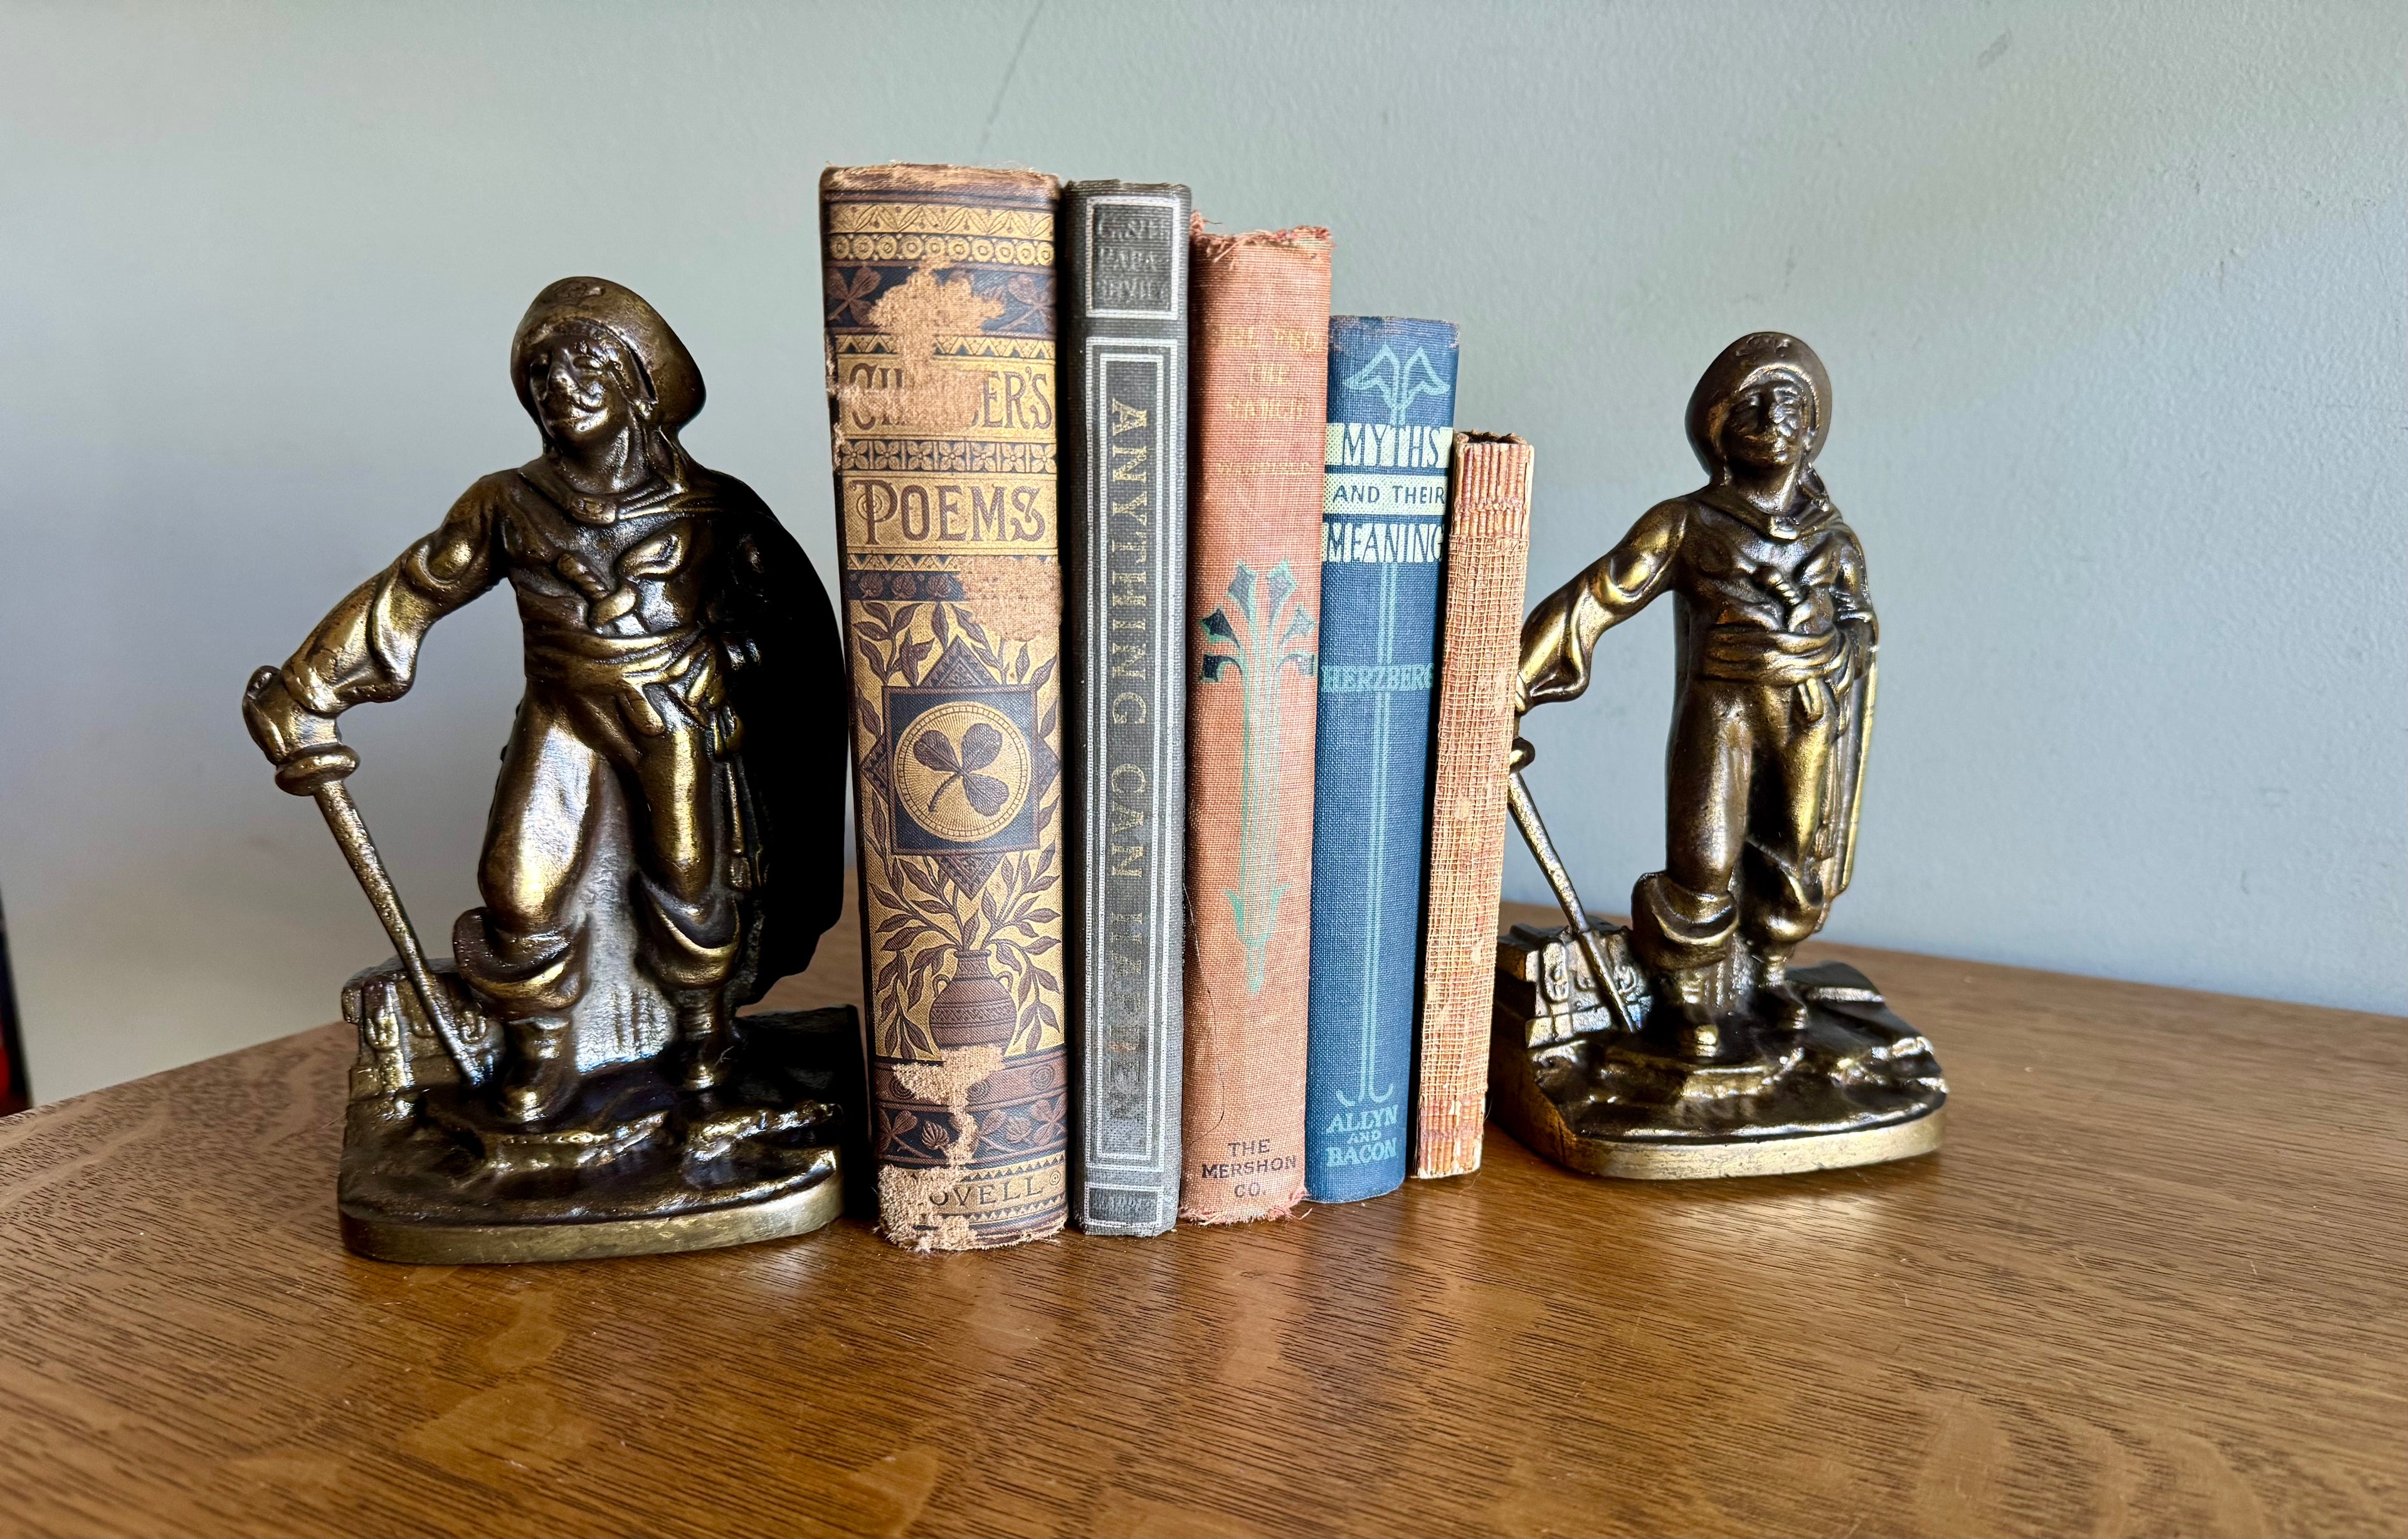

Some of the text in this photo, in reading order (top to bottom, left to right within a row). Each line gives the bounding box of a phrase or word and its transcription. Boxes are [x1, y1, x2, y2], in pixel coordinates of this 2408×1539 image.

[1342, 423, 1441, 469] MYTHS
[1332, 485, 1445, 505] AND THEIR
[850, 479, 1045, 545] POEMS
[1327, 522, 1444, 563] MEANING
[1112, 397, 1148, 725] ANYTHING
[1111, 763, 1146, 878] CAN
[1326, 1104, 1398, 1134] ALLYN
[1227, 1138, 1271, 1158] THE
[1348, 1129, 1382, 1144] AND
[1201, 1154, 1297, 1179] MERSHON
[1326, 1137, 1397, 1167] BACON
